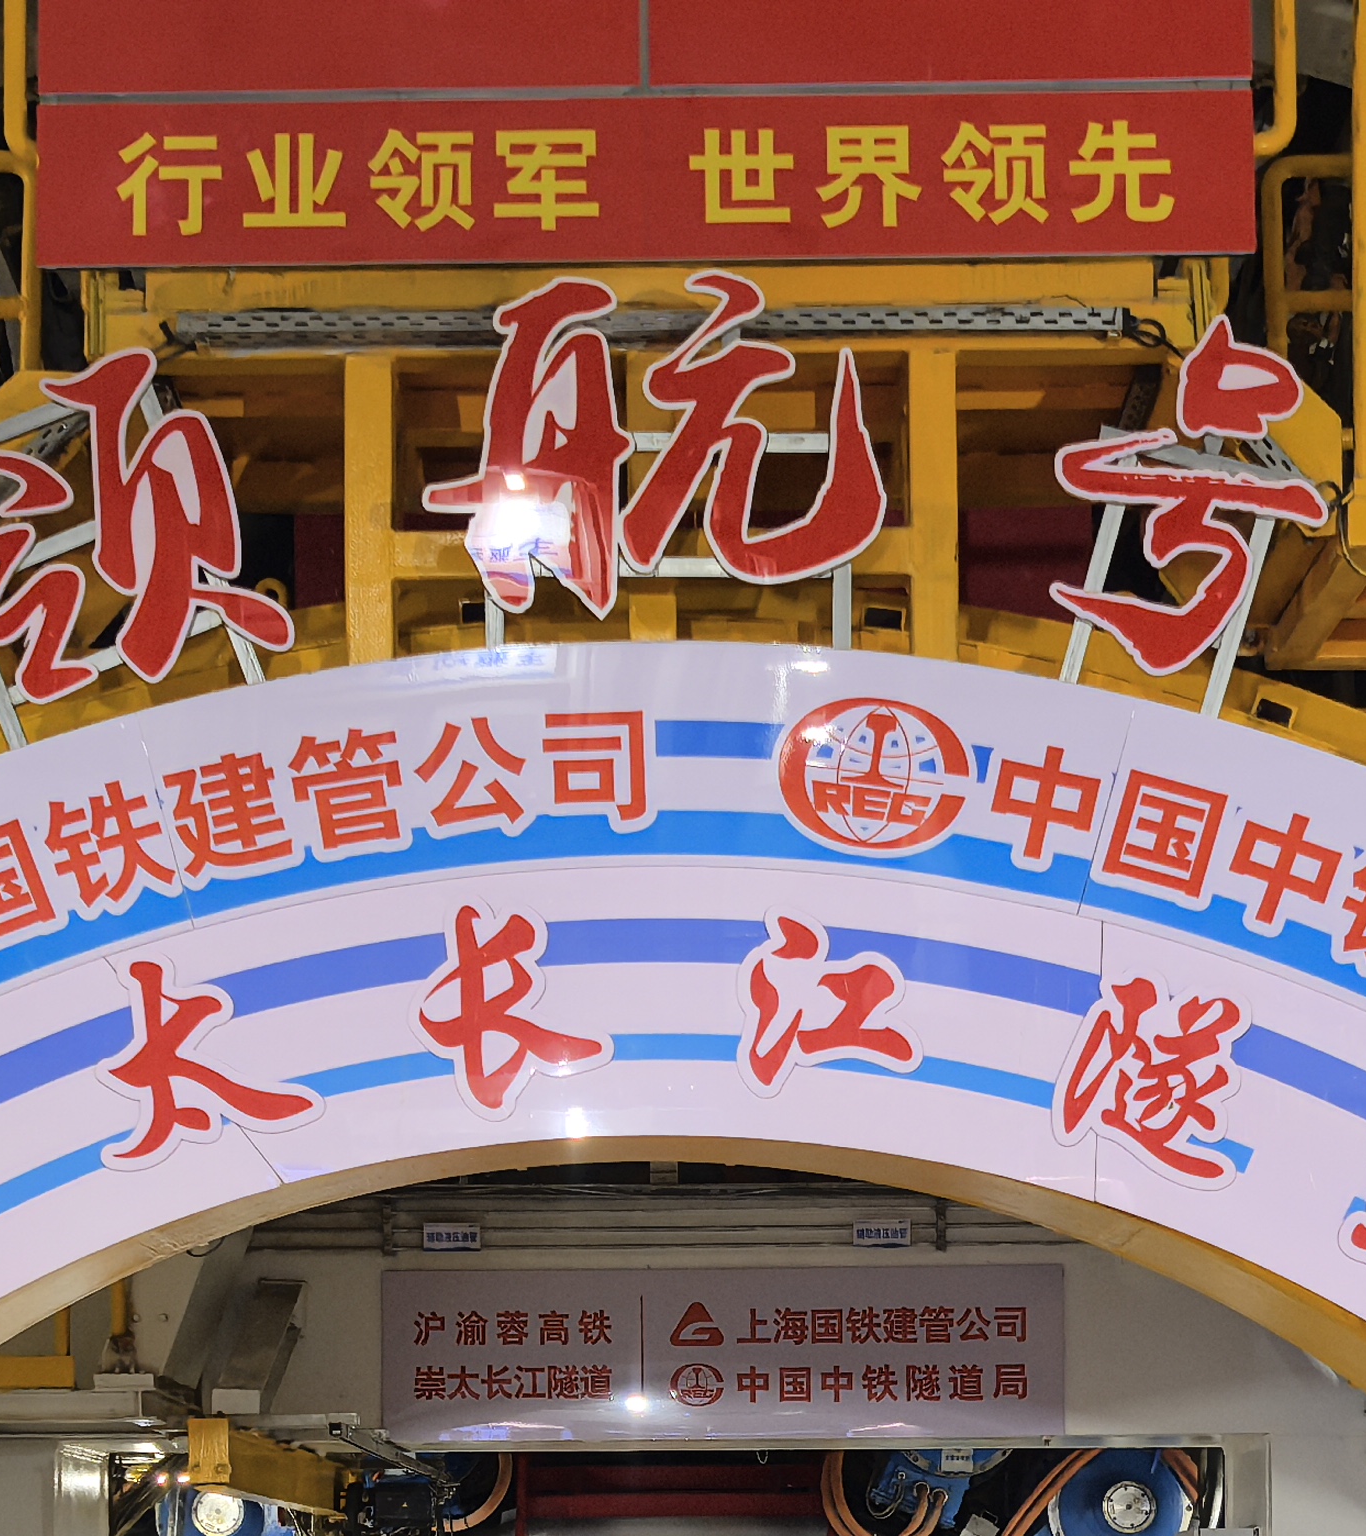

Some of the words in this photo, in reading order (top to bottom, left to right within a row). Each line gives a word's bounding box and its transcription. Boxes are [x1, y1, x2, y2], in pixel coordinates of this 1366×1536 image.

[117, 129, 600, 236] 行业领军
[688, 120, 1176, 228] 世界领先
[413, 1310, 612, 1346] 沪渝蓉高铁
[736, 1305, 1027, 1345] 上海国铁建管公司
[413, 1364, 614, 1400] 崇太长江隧道
[736, 1364, 1029, 1403] 中国中铁隧道局
